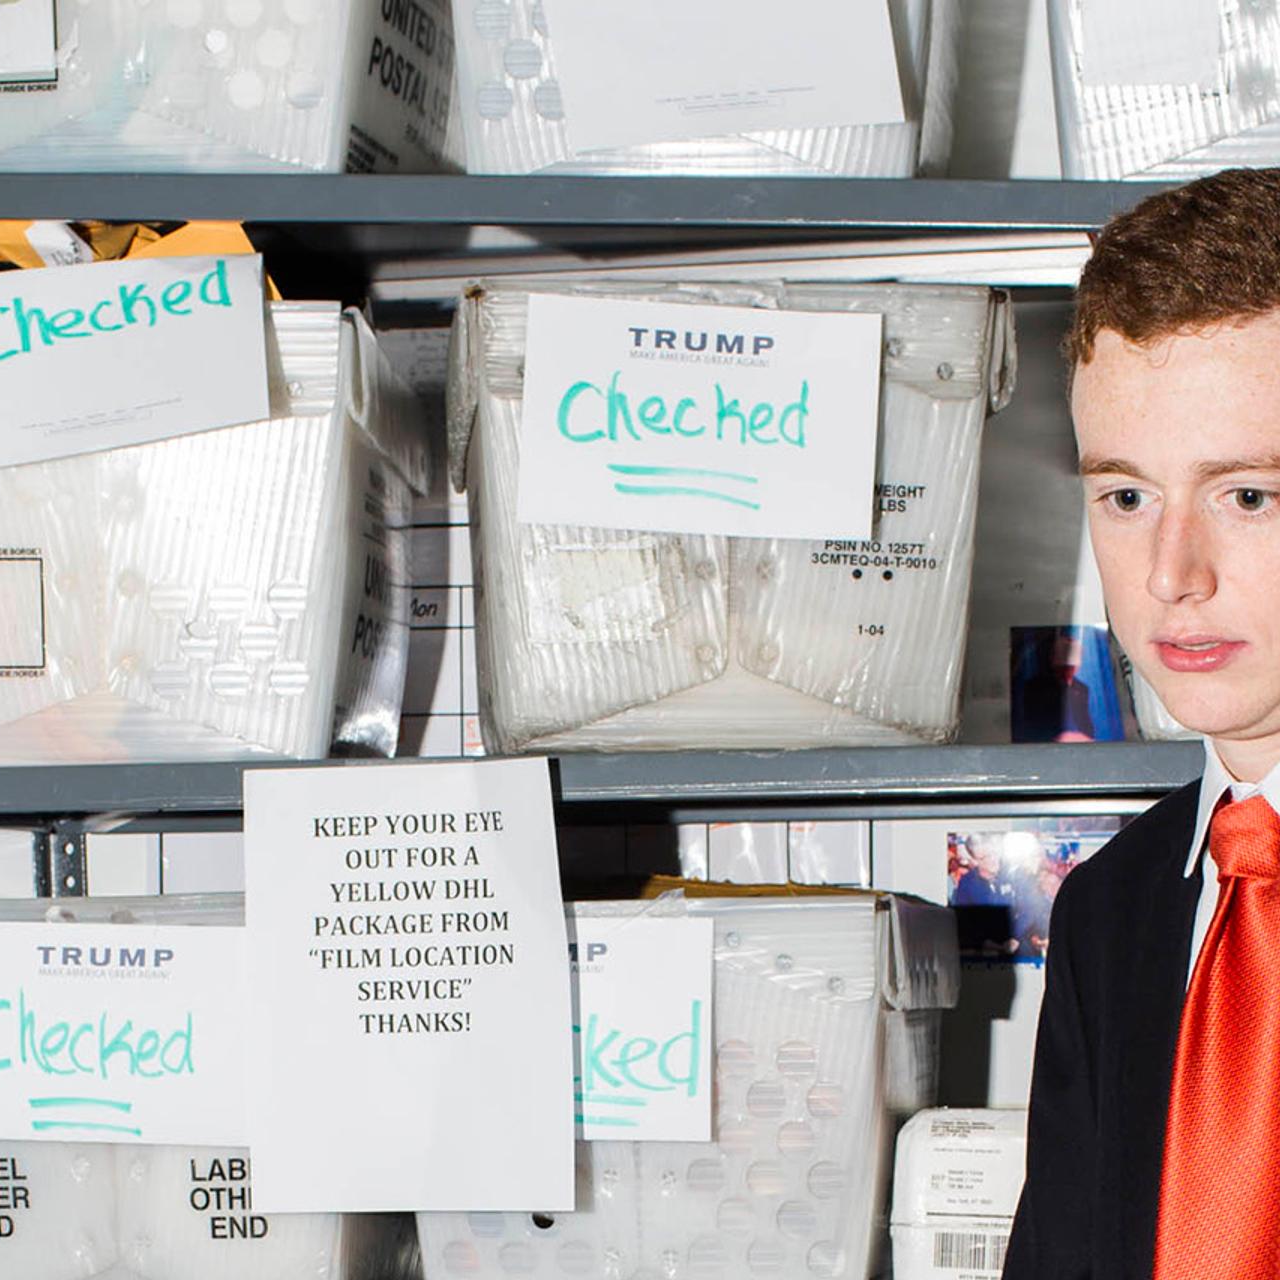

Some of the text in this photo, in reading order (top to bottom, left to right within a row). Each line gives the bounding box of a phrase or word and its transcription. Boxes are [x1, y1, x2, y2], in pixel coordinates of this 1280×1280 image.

[628, 327, 775, 355] TRUMP
[557, 369, 811, 448] Checked
[878, 499, 907, 513] LBS
[824, 540, 925, 555] PSIN NO. 1257T
[811, 552, 937, 570] 3CMTEQ-04-T-0010
[858, 624, 885, 636] 1-04
[313, 811, 504, 838] KEEP YOUR EYE
[345, 846, 481, 870] OUT FOR A
[330, 878, 495, 904] YELLOW DHL
[314, 911, 510, 937] PACKAGE FROM
[37, 945, 174, 968] TRUMP
[391, 944, 515, 969] LOCATION
[359, 1012, 472, 1035] THANKS!
[211, 1216, 269, 1239] END
